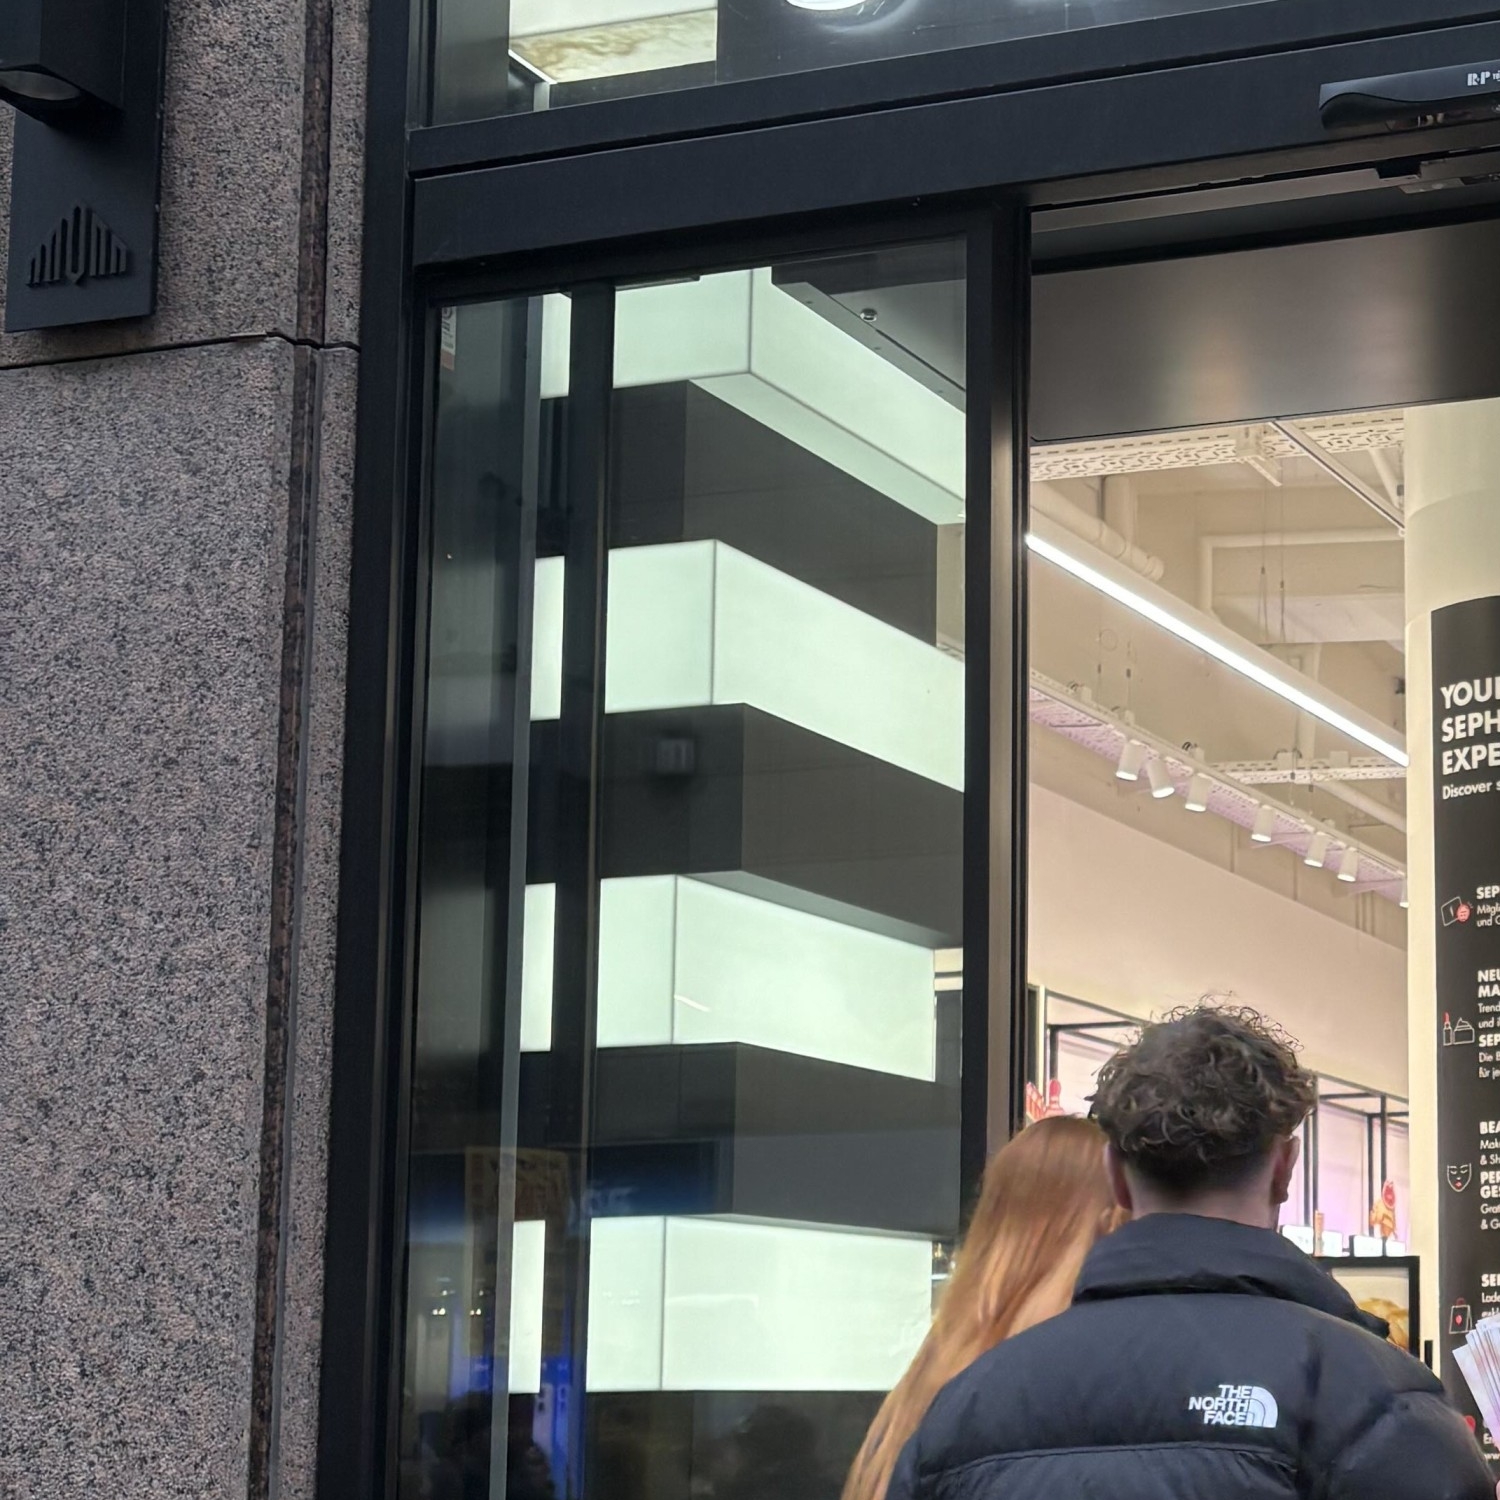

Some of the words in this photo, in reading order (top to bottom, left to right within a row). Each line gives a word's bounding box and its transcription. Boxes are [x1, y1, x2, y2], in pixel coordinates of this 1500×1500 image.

[1442, 780, 1492, 799] Discover
[1477, 916, 1493, 927] und
[1478, 1017, 1495, 1029] und
[1479, 1052, 1493, 1063] Die
[1480, 1154, 1488, 1166] &
[1480, 1219, 1488, 1230] &
[1218, 1384, 1253, 1399] THE
[1188, 1396, 1249, 1412] NORTH
[1203, 1411, 1247, 1425] FACE
